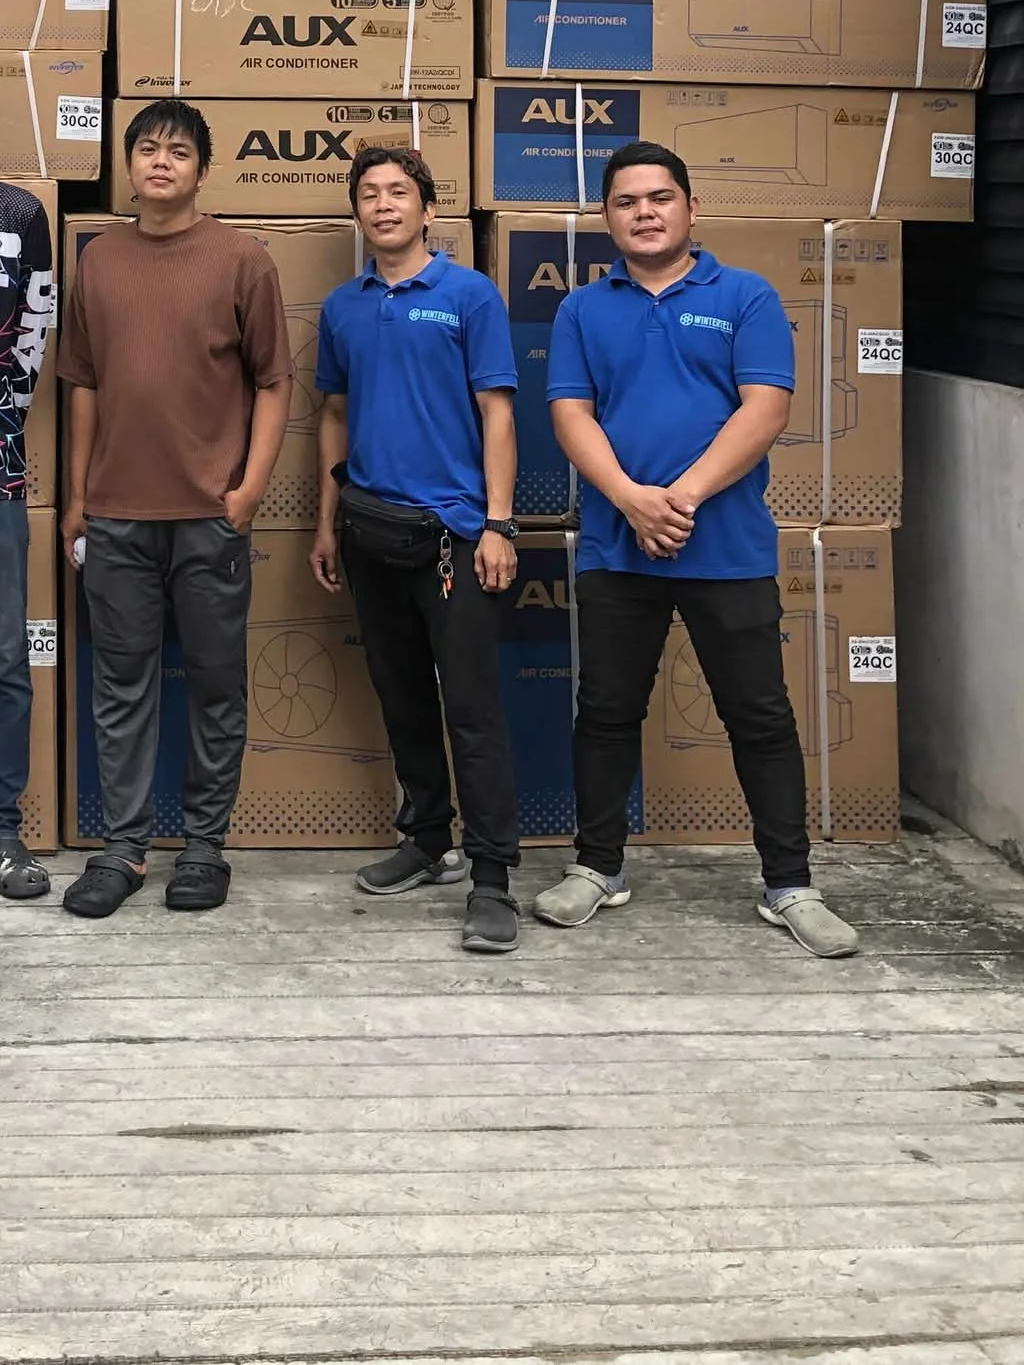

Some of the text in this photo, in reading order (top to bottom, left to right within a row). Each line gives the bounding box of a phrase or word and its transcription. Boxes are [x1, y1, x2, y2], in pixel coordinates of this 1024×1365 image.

[239, 15, 357, 46] AUX
[946, 21, 984, 35] 24QC
[239, 58, 358, 69] AIR CONDITIONER
[414, 83, 461, 91] TECHNOLOGY
[328, 107, 348, 122] 10
[382, 107, 392, 122] 5
[521, 97, 614, 125] AUX
[60, 114, 99, 128] 30QC
[235, 130, 353, 162] AUX
[521, 148, 540, 156] AIR
[935, 152, 973, 165] 30QC
[235, 173, 258, 183] AIR
[421, 309, 460, 324] WINTERFELL
[694, 315, 733, 331] WINTERFELL
[862, 347, 902, 361] 24QC
[853, 656, 893, 669] 24QC
